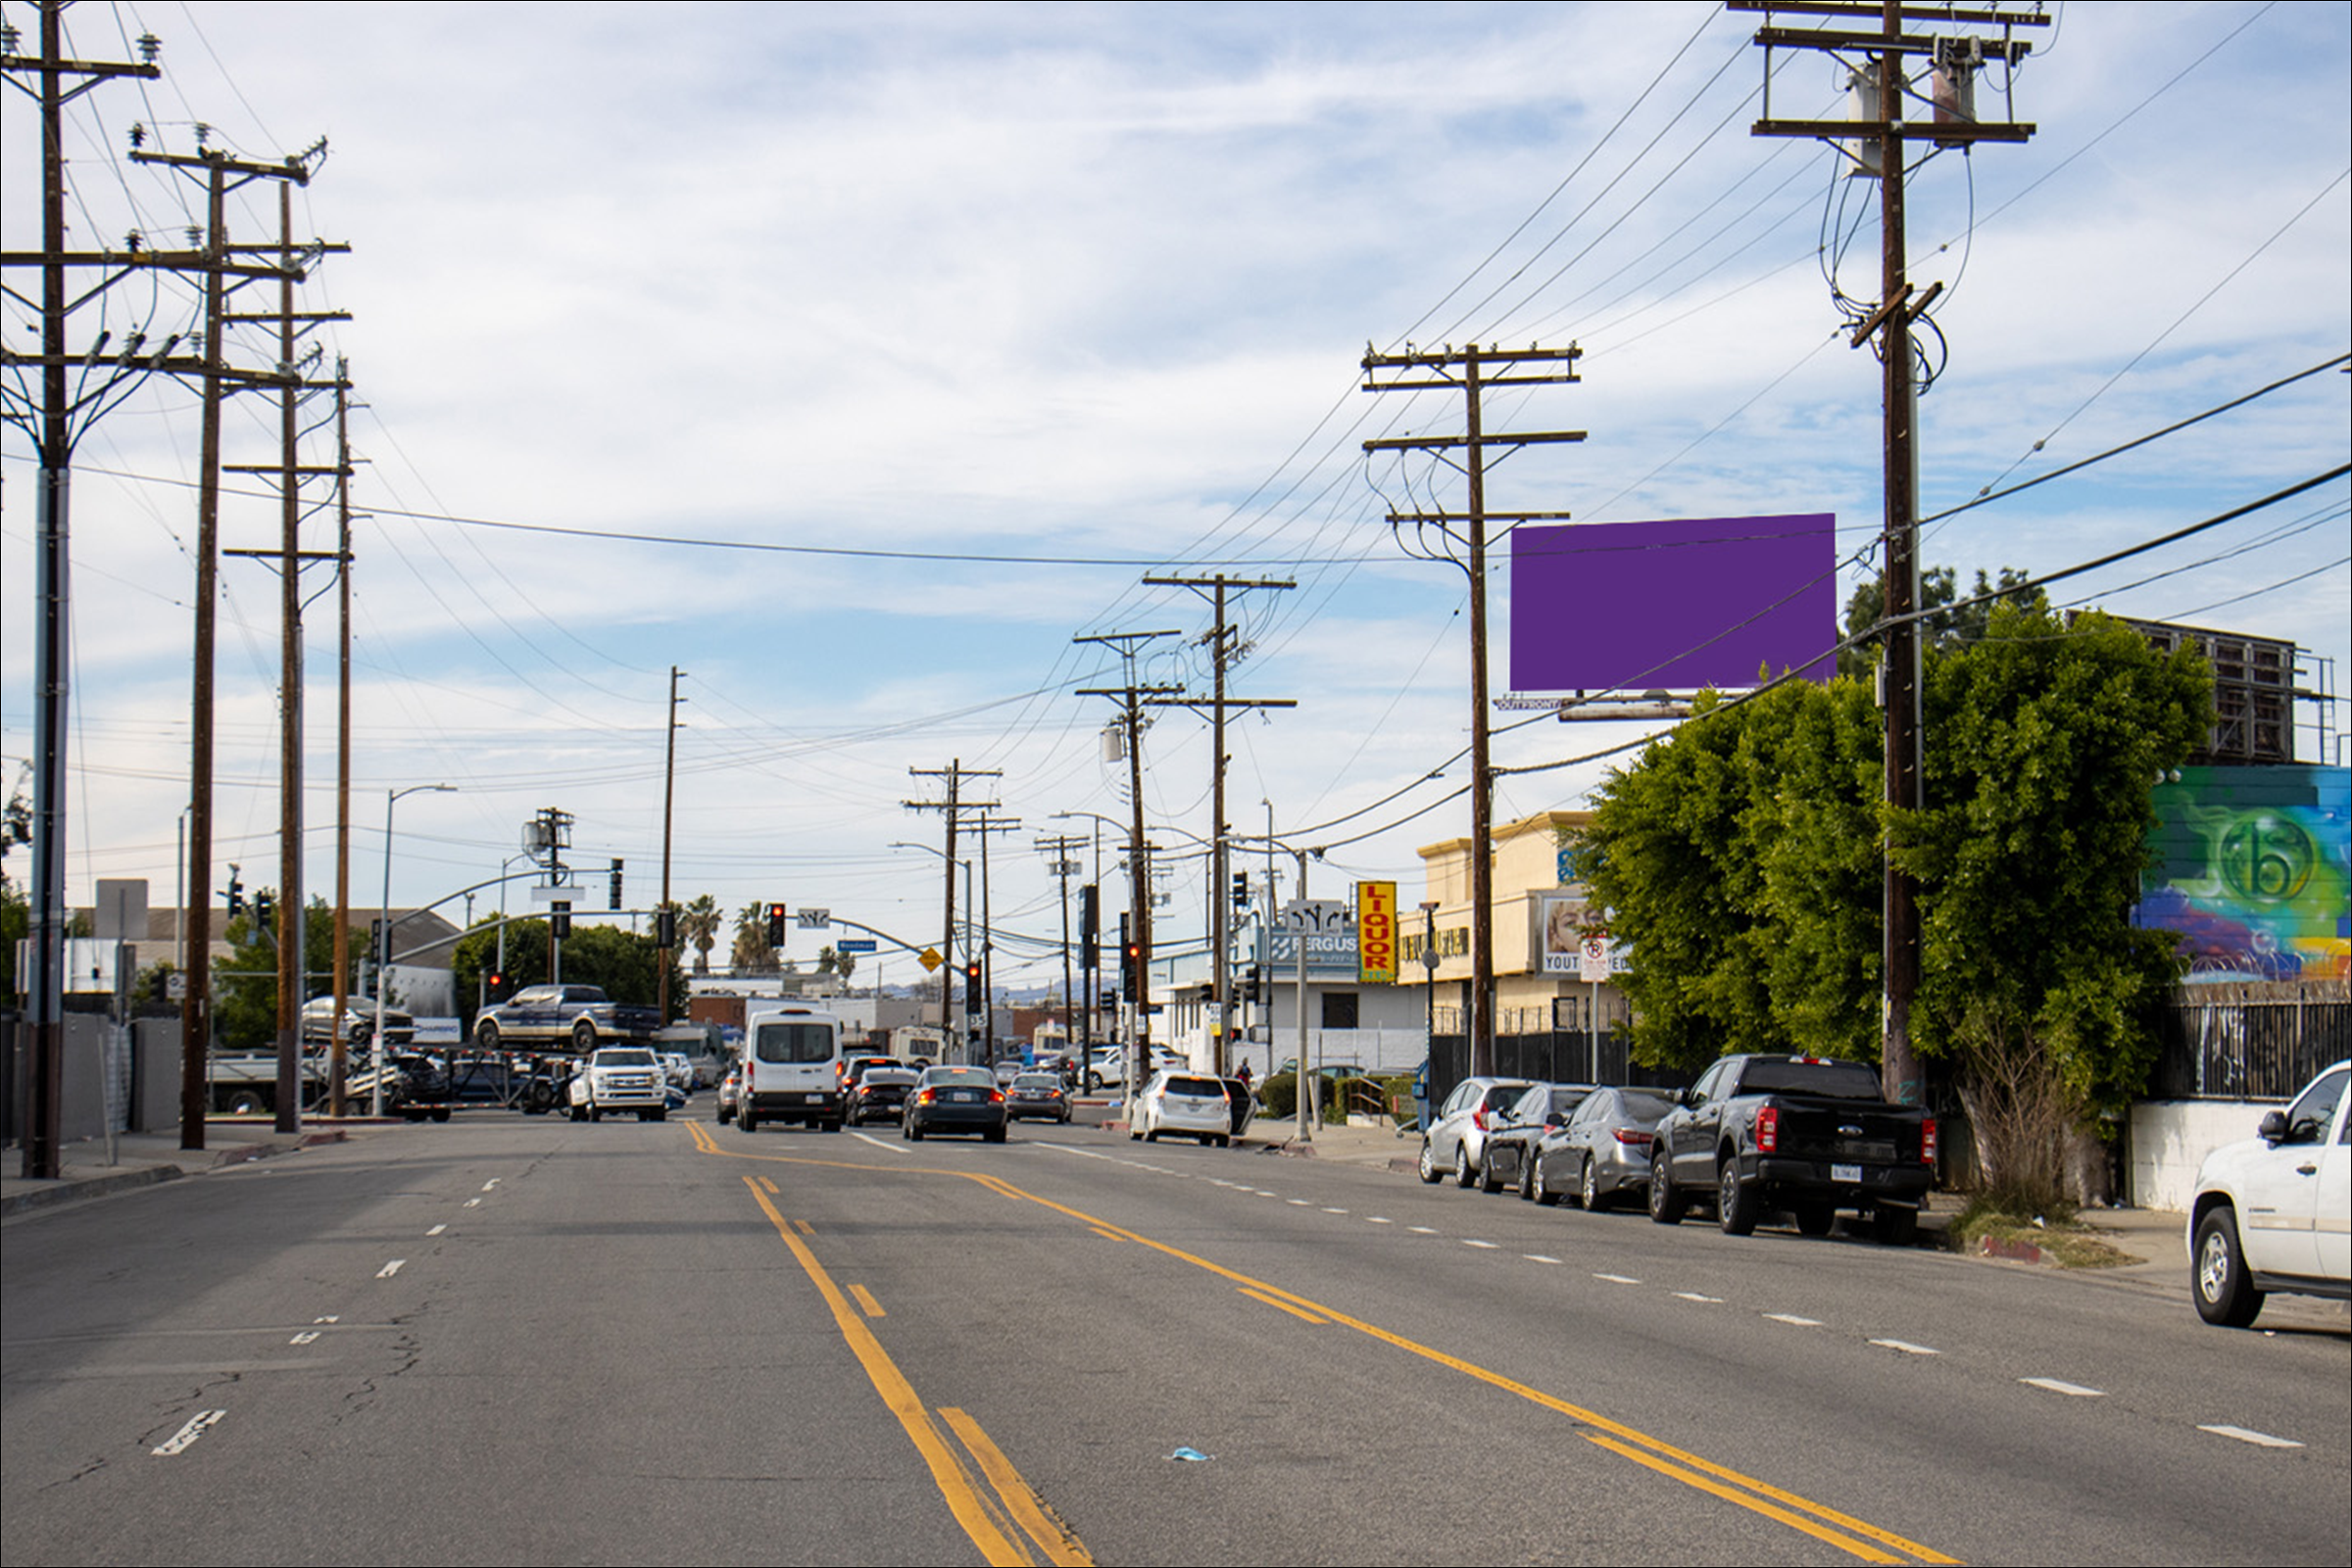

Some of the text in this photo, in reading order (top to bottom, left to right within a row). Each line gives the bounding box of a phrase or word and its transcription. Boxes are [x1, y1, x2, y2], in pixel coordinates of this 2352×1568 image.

[1363, 885, 1390, 969] LIQUOR
[1292, 937, 1357, 952] FERGUS
[1545, 956, 1580, 969] YOUT
[970, 1015, 985, 1025] 35
